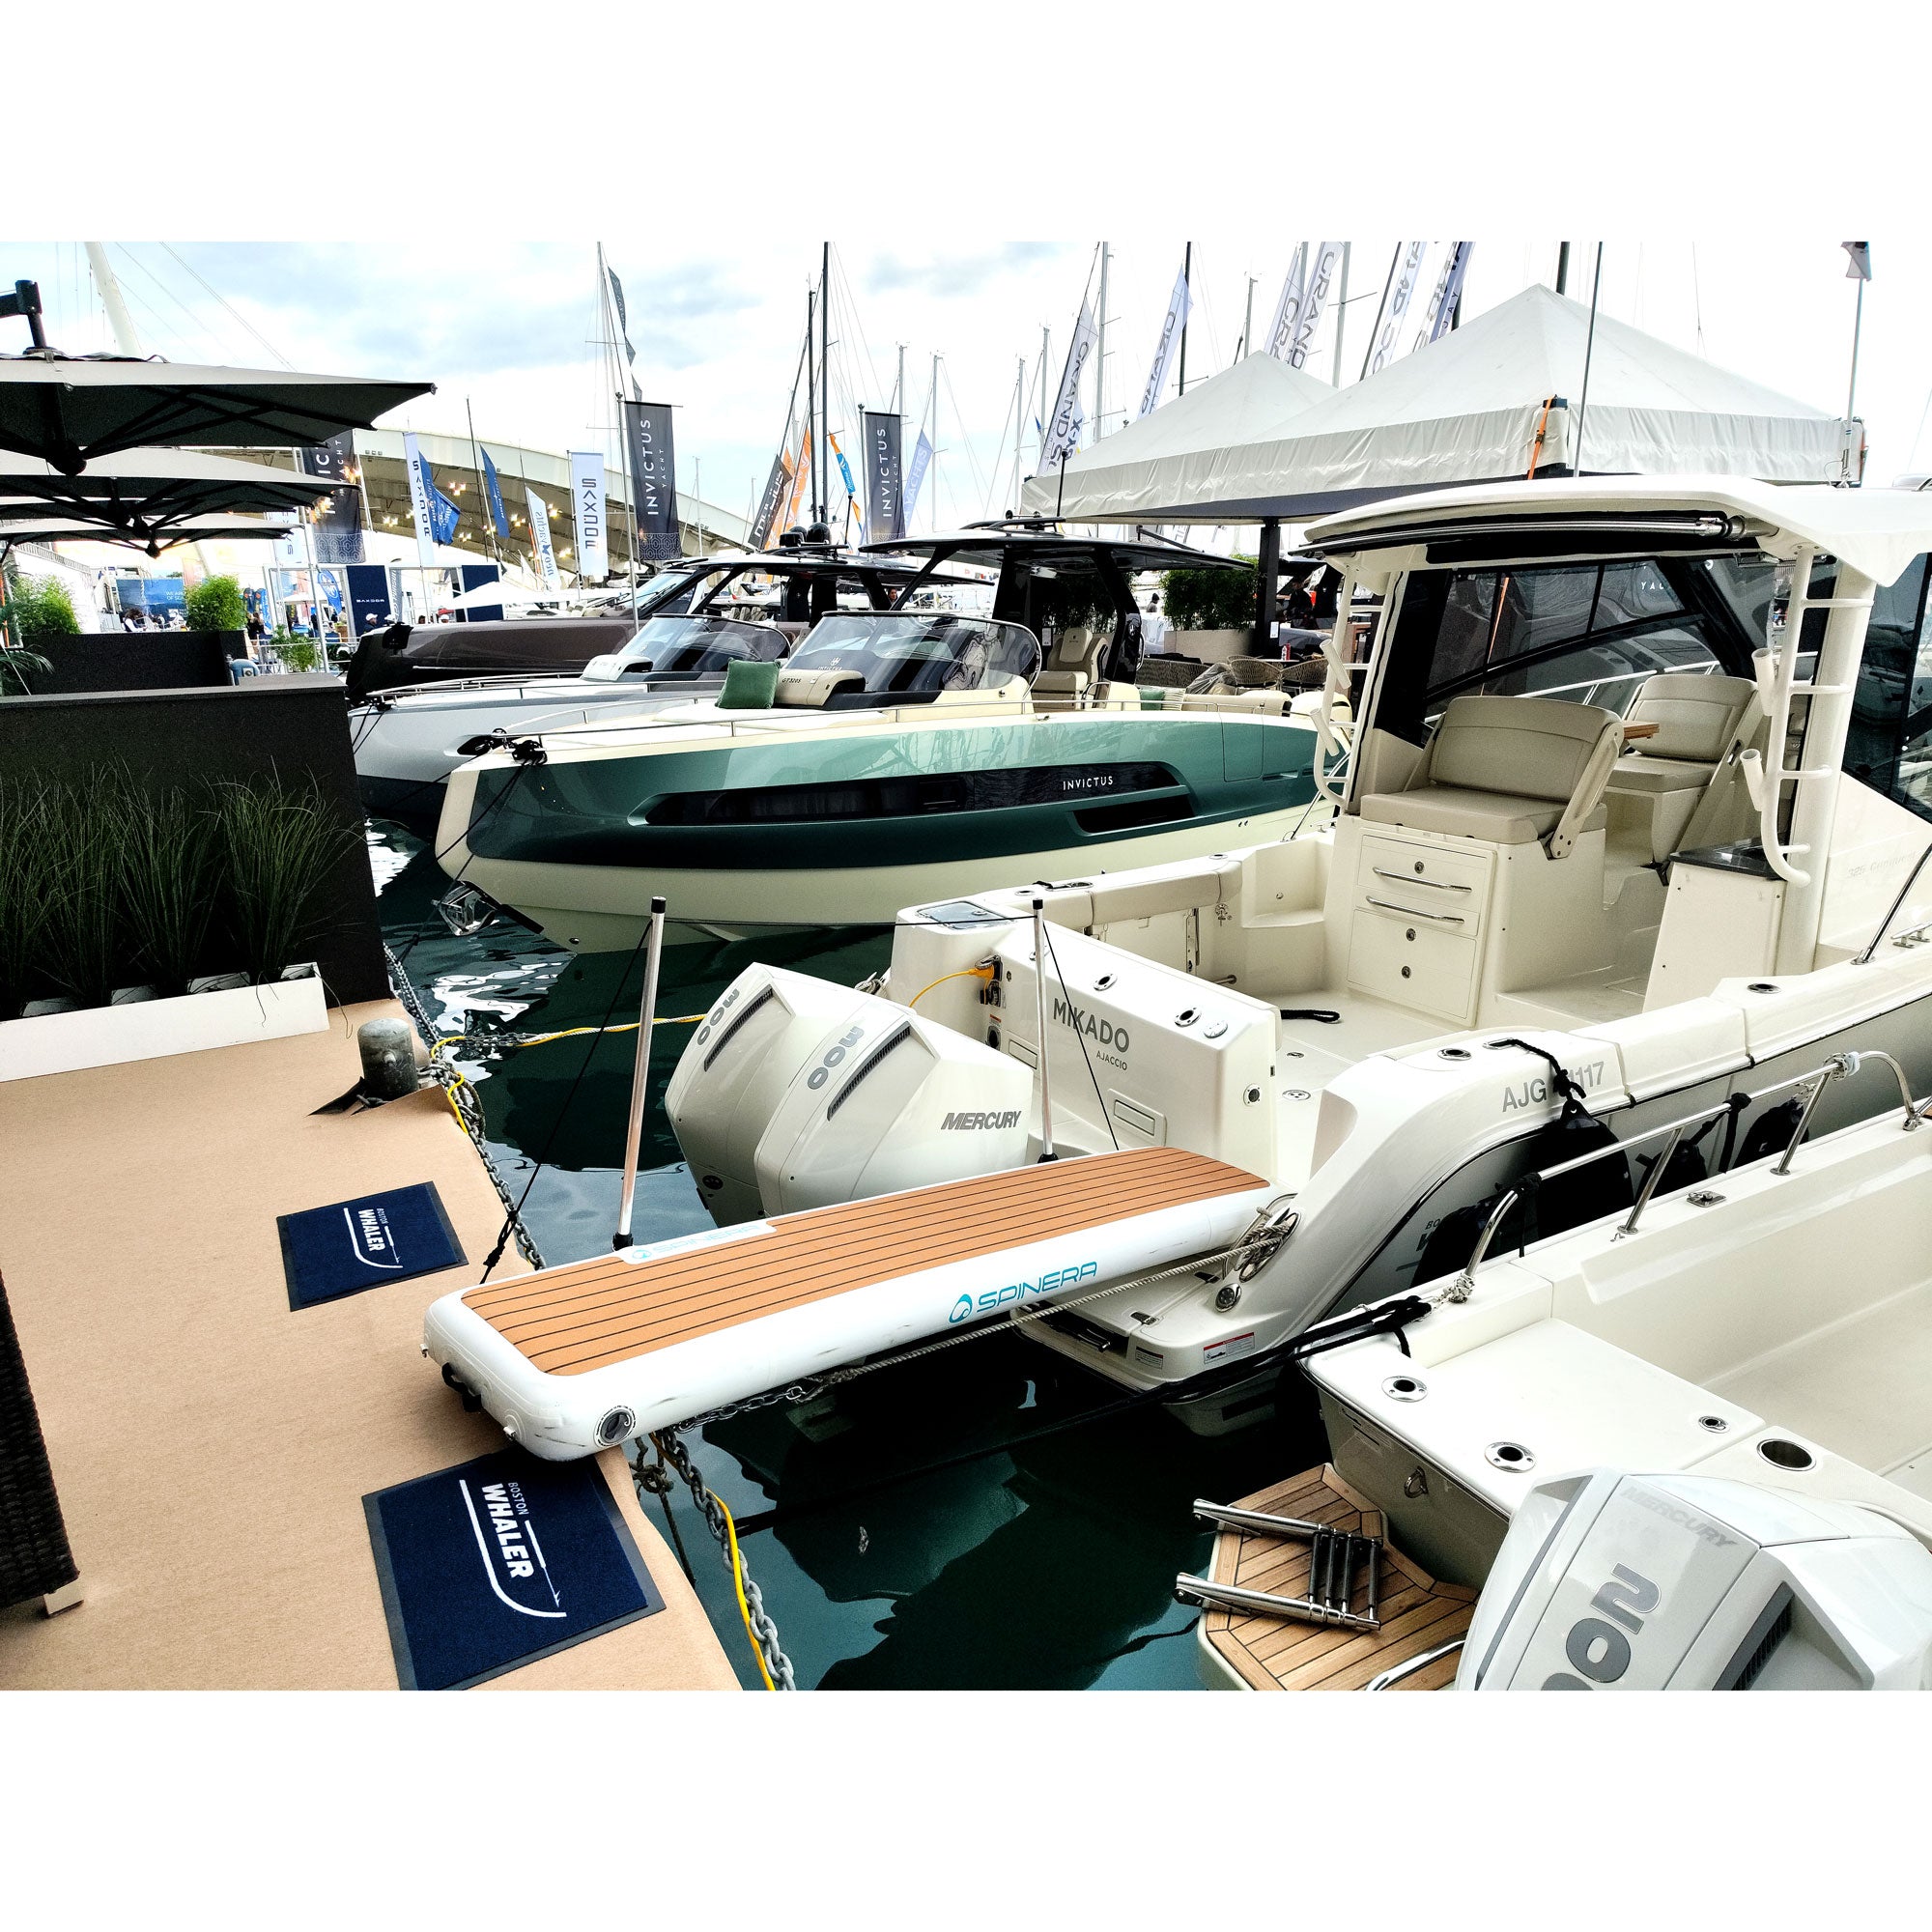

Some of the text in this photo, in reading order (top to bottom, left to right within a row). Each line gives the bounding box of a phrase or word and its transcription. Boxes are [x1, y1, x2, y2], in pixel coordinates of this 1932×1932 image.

[639, 419, 659, 515] INVICTUS
[659, 448, 668, 488] YACHT
[877, 428, 893, 517] INVICTUS
[1063, 775, 1114, 791] INVICTUS
[696, 988, 740, 1046] 300
[1053, 997, 1129, 1053] MIKADO
[807, 1026, 865, 1091] 300
[1095, 1050, 1127, 1071] AJACCIO
[940, 1110, 1022, 1130] MERCURY
[357, 1208, 386, 1252] WHALER
[376, 1208, 389, 1224] BOSTON
[976, 1261, 1097, 1313] SPINERA
[507, 1481, 530, 1516] BOSTON
[1619, 1485, 1738, 1548] MERCURY
[481, 1483, 534, 1578] WHALER
